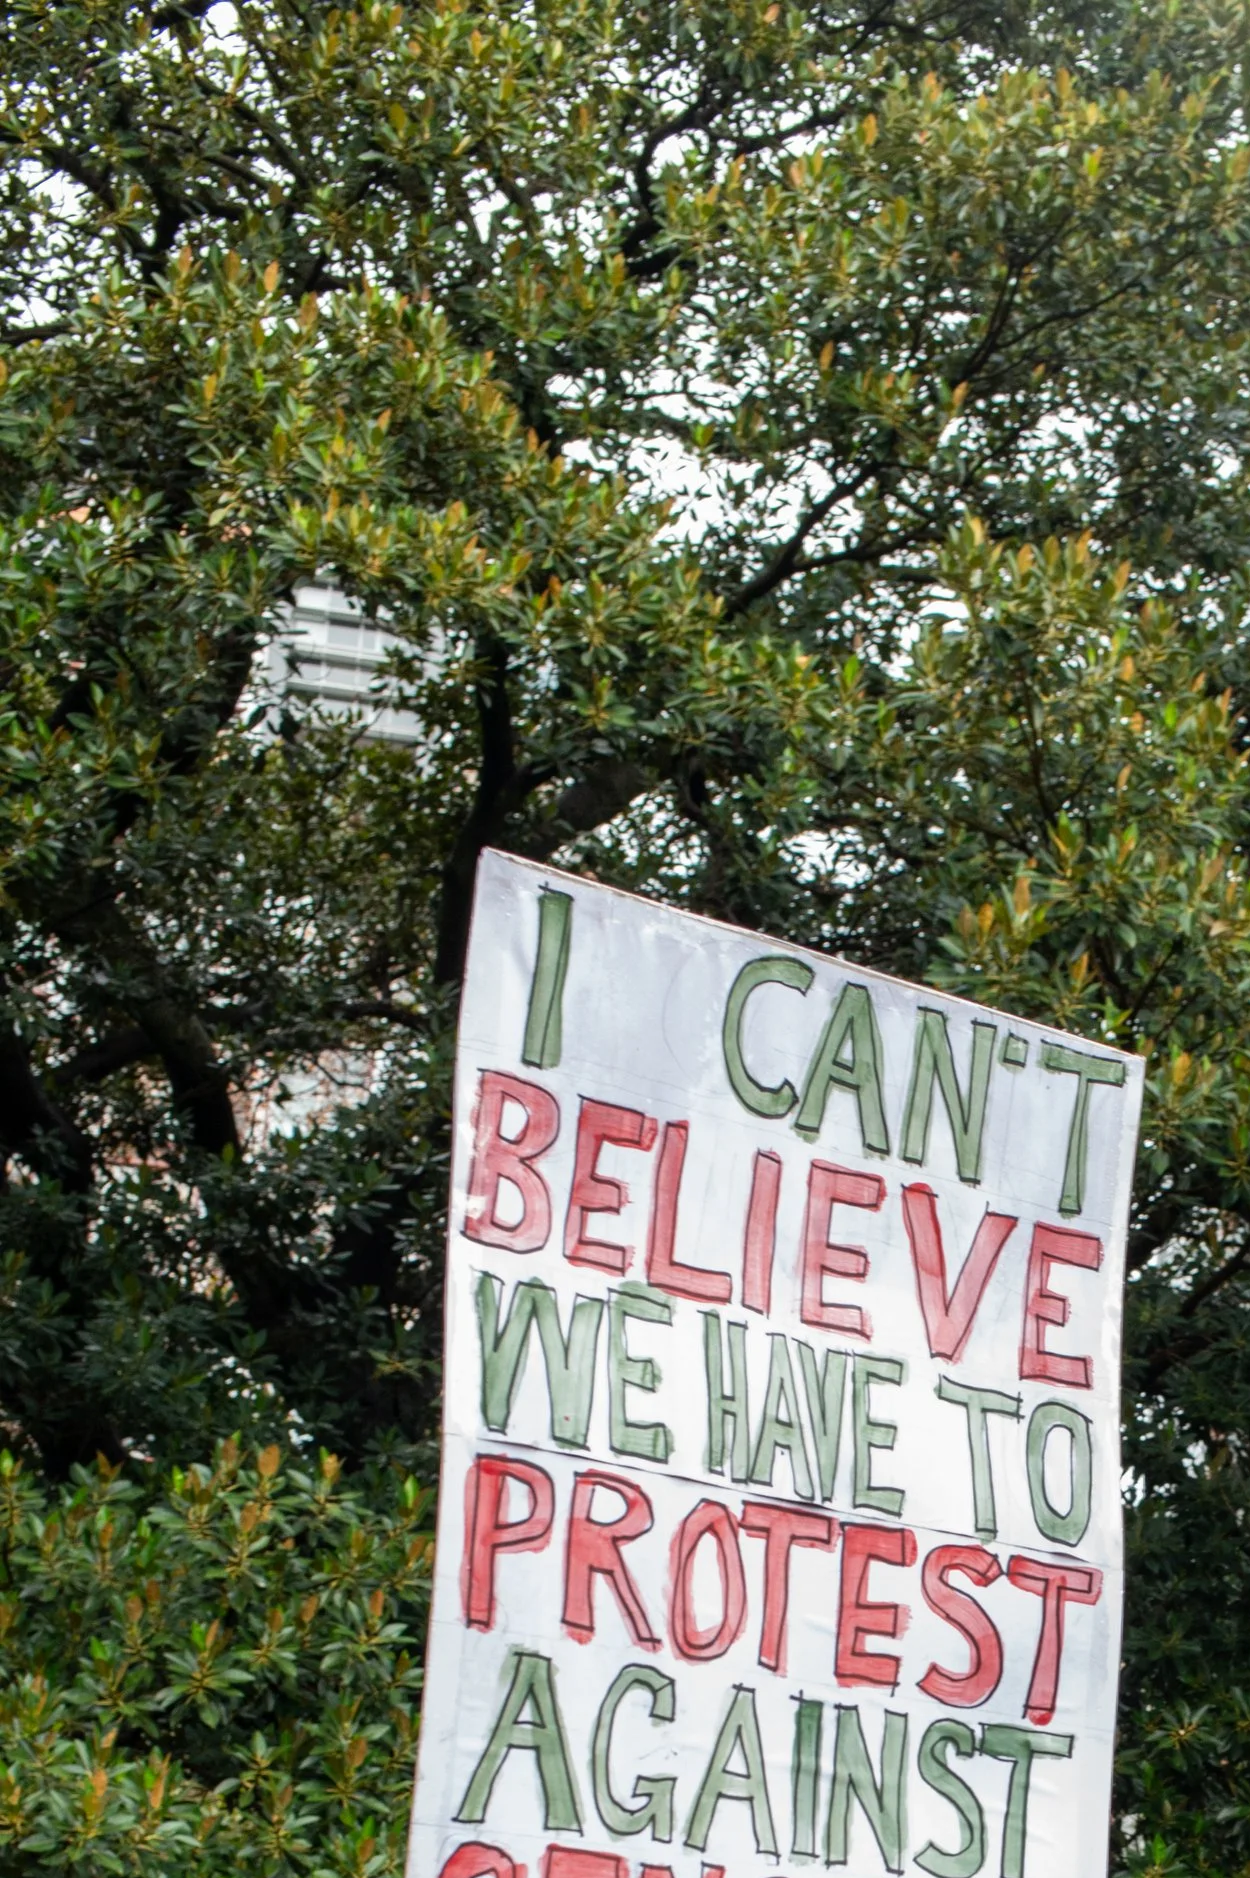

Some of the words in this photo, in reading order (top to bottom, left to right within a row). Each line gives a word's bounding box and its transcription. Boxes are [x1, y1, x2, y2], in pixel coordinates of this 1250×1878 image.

[521, 882, 575, 1069] I
[722, 955, 1127, 1218] CAN'T
[461, 1067, 1103, 1388] BELIEVE
[472, 1267, 675, 1463] WE
[697, 1309, 907, 1516] HAVE
[936, 1373, 1093, 1547] TO
[459, 1453, 1102, 1725] PROTEST
